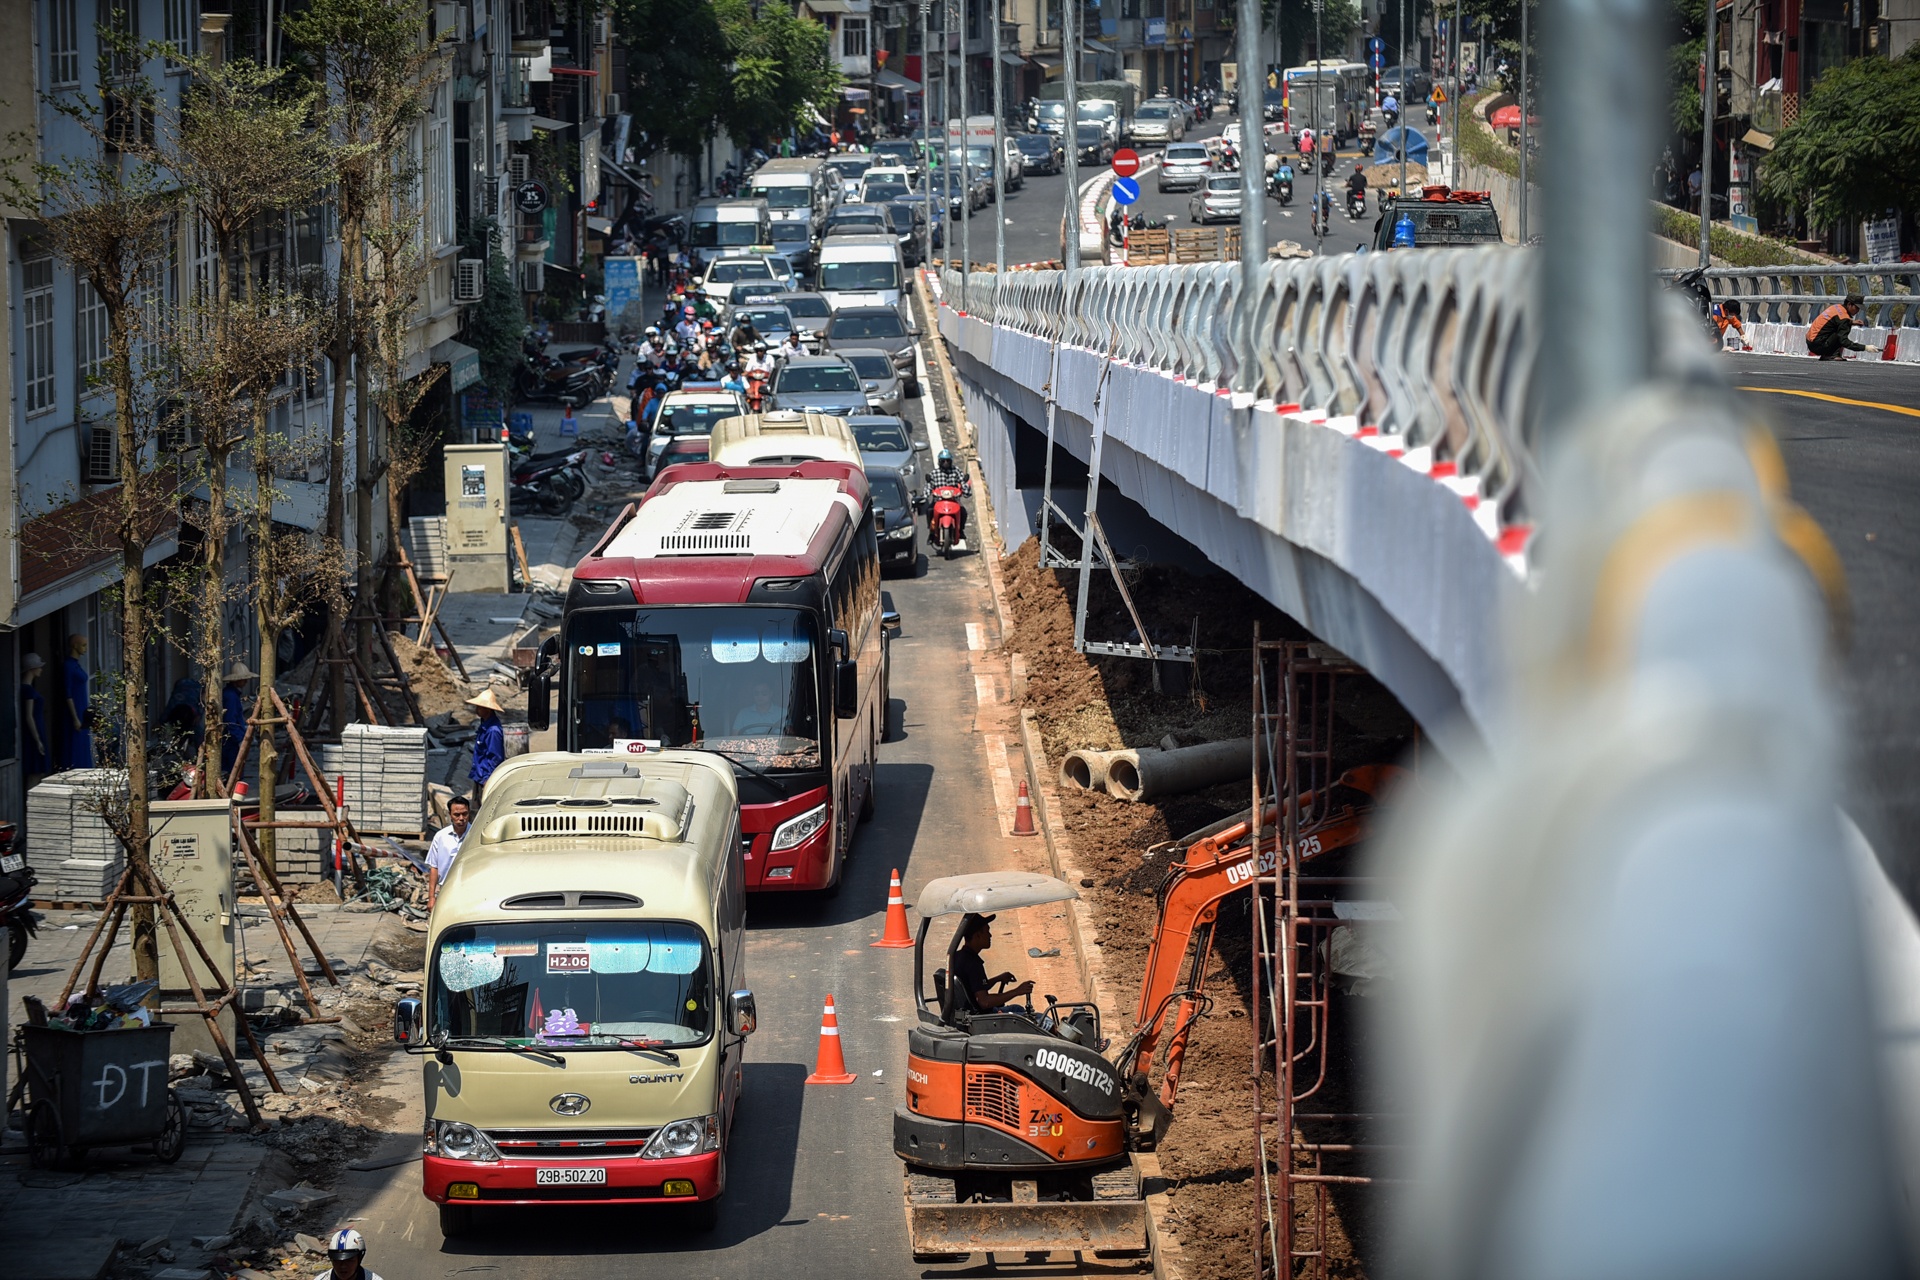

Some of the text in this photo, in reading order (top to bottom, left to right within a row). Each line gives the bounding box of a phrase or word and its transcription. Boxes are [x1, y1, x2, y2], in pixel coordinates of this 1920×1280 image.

[550, 956, 588, 968] H2.06
[629, 1073, 684, 1083] COUNTY
[907, 1069, 928, 1085] ITACHI
[1035, 1048, 1115, 1096] 0906261725
[92, 1060, 166, 1109] ĐT
[1028, 1125, 1063, 1137] 35U
[538, 1169, 604, 1183] 29B-502.20
